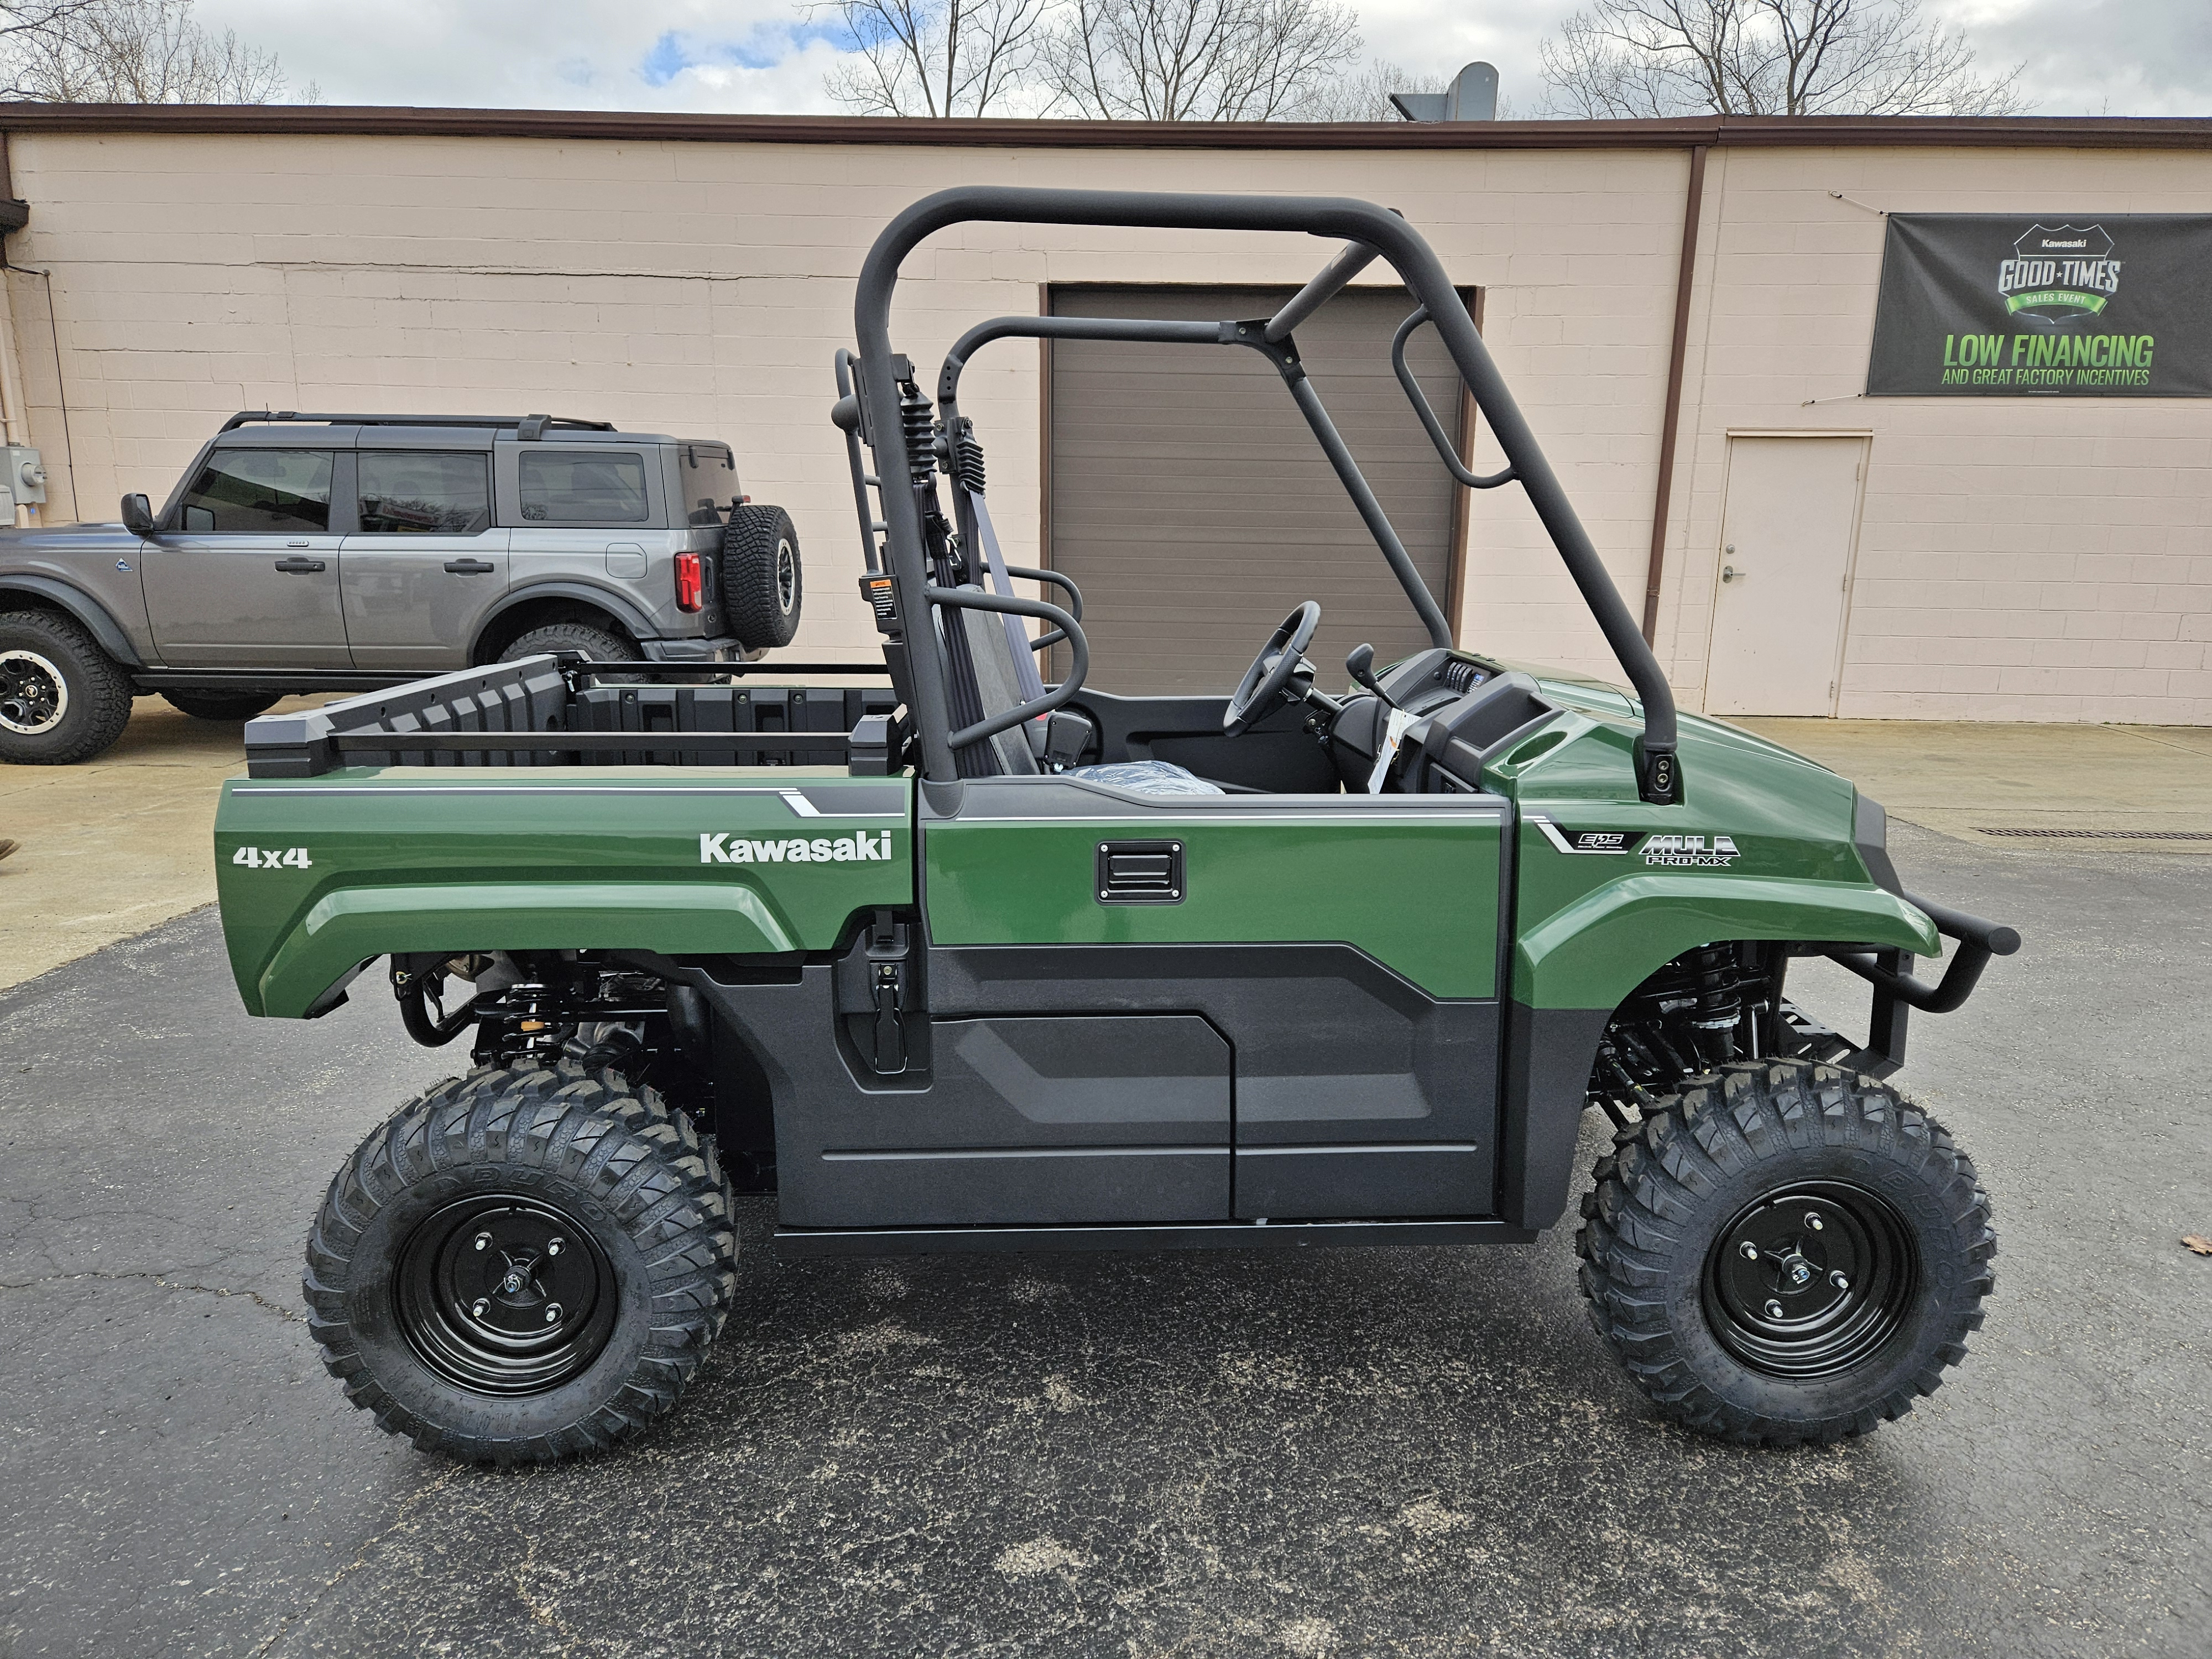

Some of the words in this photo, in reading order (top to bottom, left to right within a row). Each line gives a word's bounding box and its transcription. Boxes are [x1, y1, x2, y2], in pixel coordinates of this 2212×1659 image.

[1998, 260, 2056, 292] GOOD
[2062, 260, 2120, 293] TIMES
[2026, 294, 2054, 304] SALES
[2058, 294, 2086, 304] EVENT
[1944, 335, 2005, 366] LOW
[2011, 335, 2154, 367] FINANCING
[1942, 369, 1969, 385] AND
[1973, 369, 2013, 385] GREAT
[2016, 369, 2074, 385] FACTORY
[2077, 369, 2150, 385] INCENTIVES
[700, 830, 891, 863] Kawasaki
[1639, 835, 1741, 857] MULE
[233, 847, 312, 869] 4x4
[1646, 855, 1732, 867] PRO-MX
[471, 1166, 608, 1221] DURO
